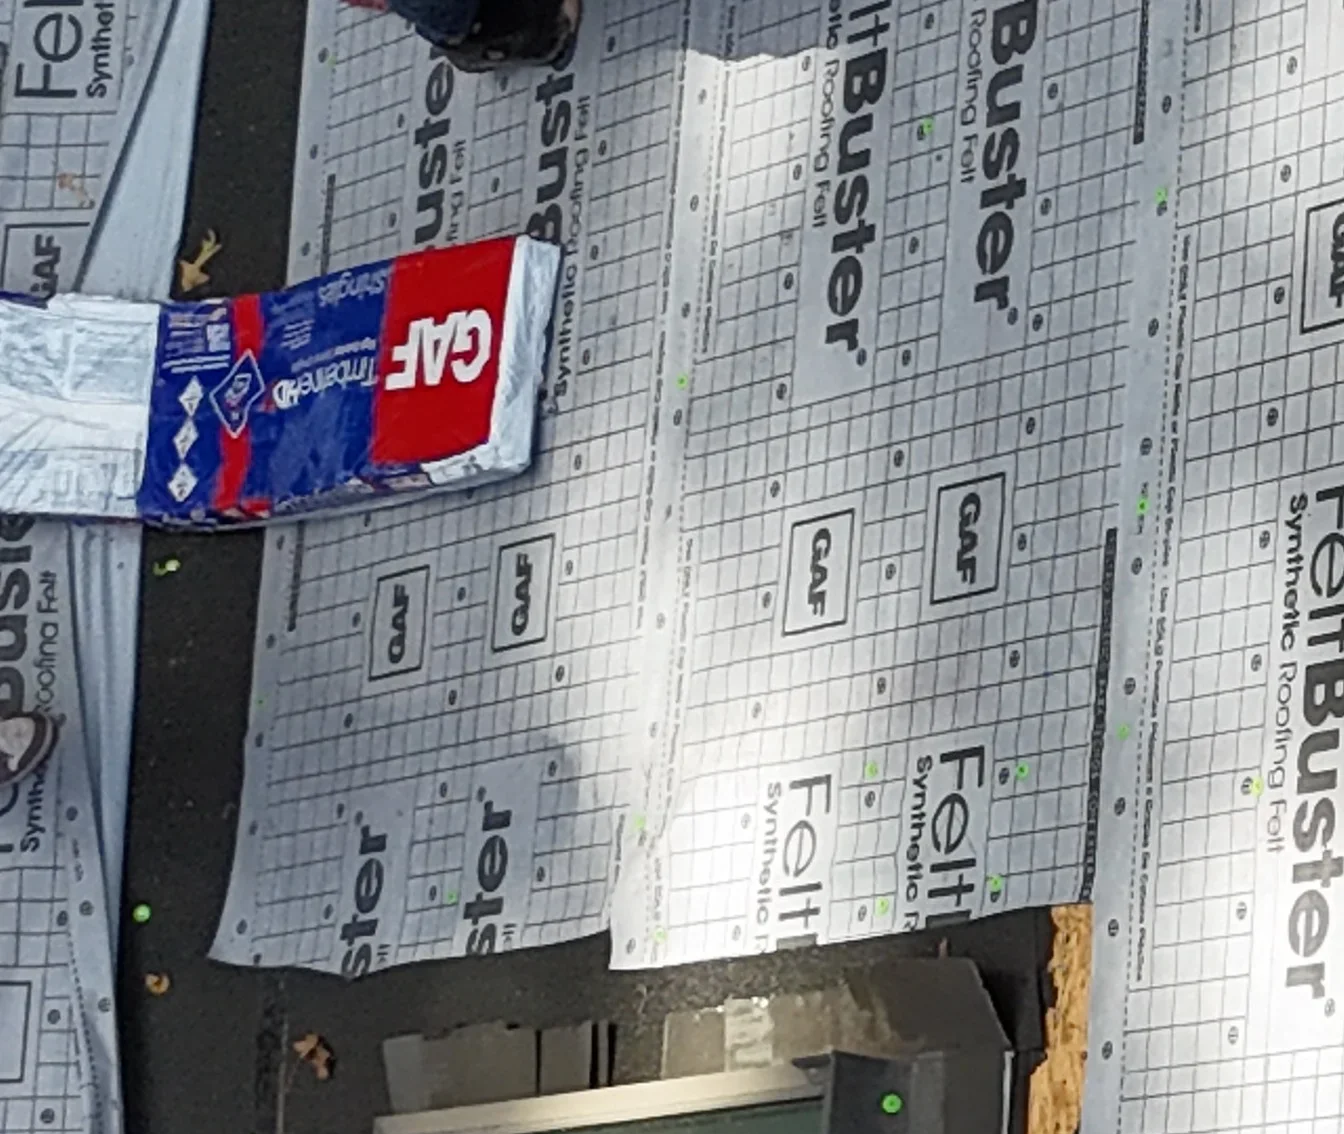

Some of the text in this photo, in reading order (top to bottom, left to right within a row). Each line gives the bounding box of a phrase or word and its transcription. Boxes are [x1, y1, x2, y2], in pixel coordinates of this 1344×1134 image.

[960, 8, 987, 184] Roofing Felt
[385, 308, 492, 390] GAF
[808, 527, 832, 618] GAF
[957, 492, 981, 585] GAF
[387, 584, 411, 664] GAF
[511, 552, 535, 635] GAF
[1266, 493, 1308, 854] Synthetic Roofing Felt
[905, 755, 933, 903] Synthetic
